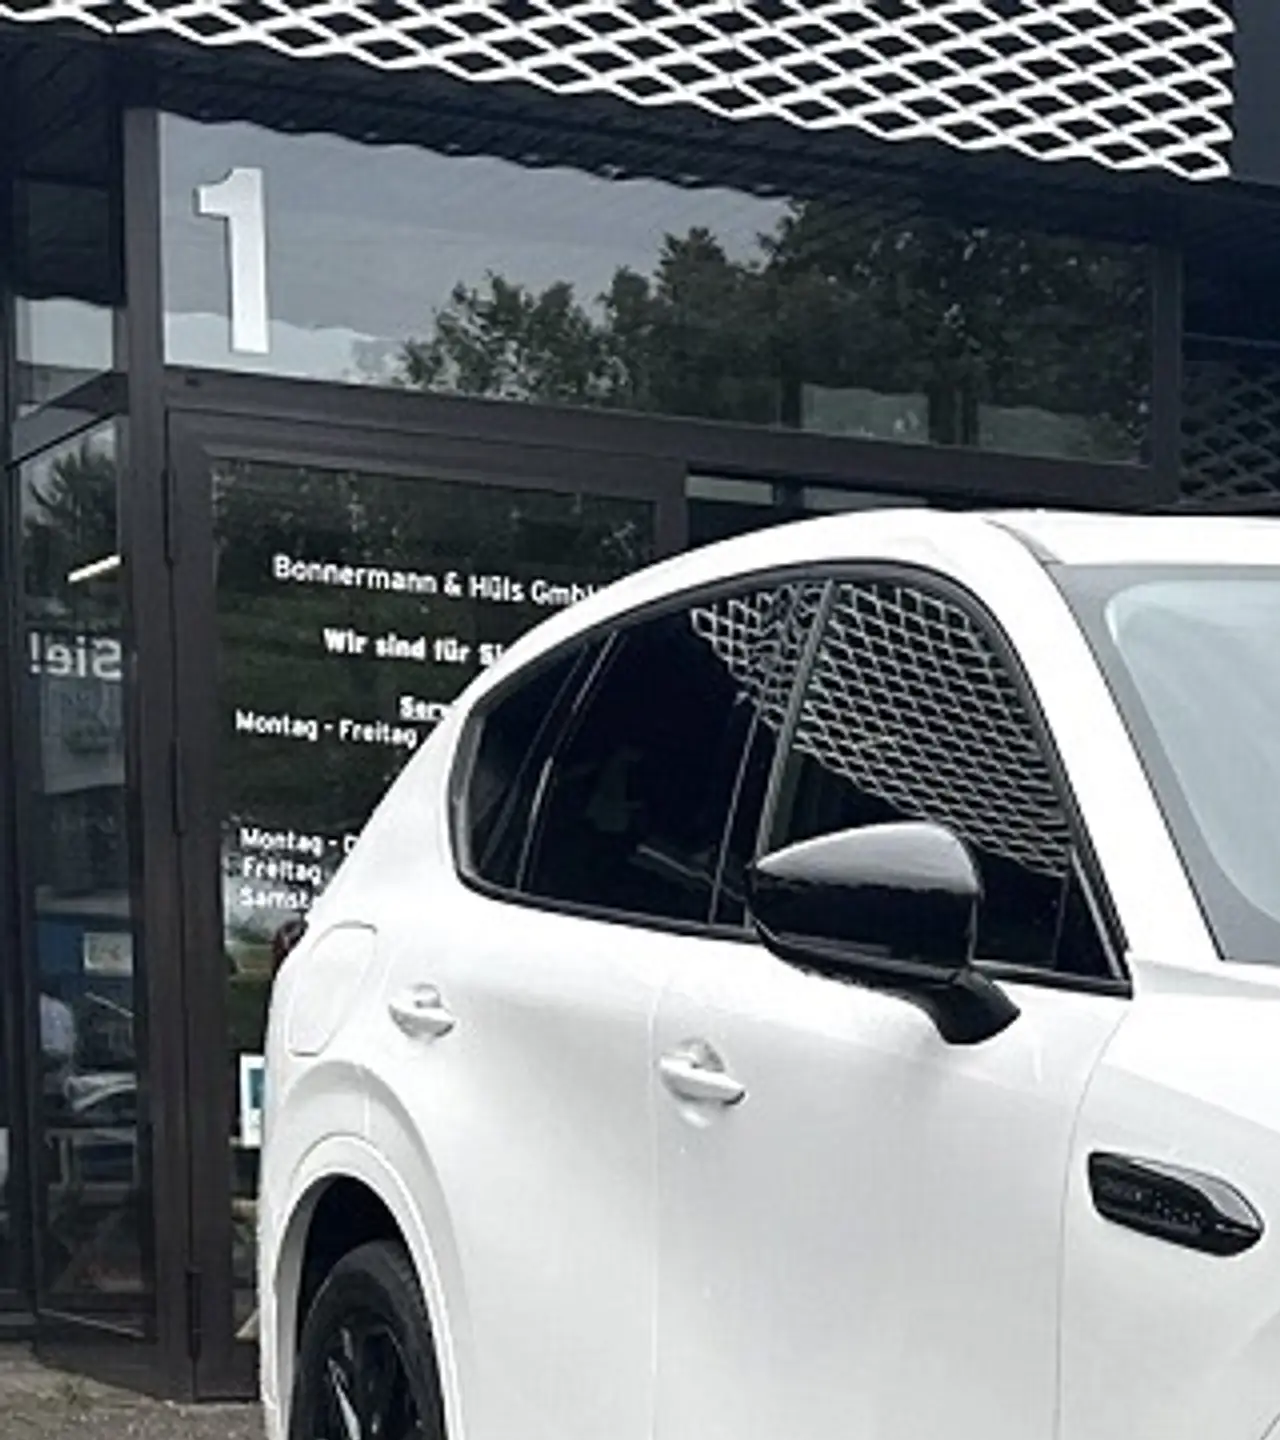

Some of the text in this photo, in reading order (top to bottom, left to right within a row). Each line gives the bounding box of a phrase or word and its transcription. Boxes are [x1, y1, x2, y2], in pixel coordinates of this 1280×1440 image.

[198, 166, 270, 354] 1
[273, 554, 437, 594] Bonnermann
[444, 572, 463, 597] &
[469, 575, 525, 602] Hüls
[323, 627, 368, 654] Wir
[375, 633, 425, 661] sind
[433, 638, 471, 662] für
[236, 708, 318, 742] Montag
[340, 718, 417, 750] Freitag
[240, 828, 322, 856] Montag
[243, 856, 321, 885] Freitag
